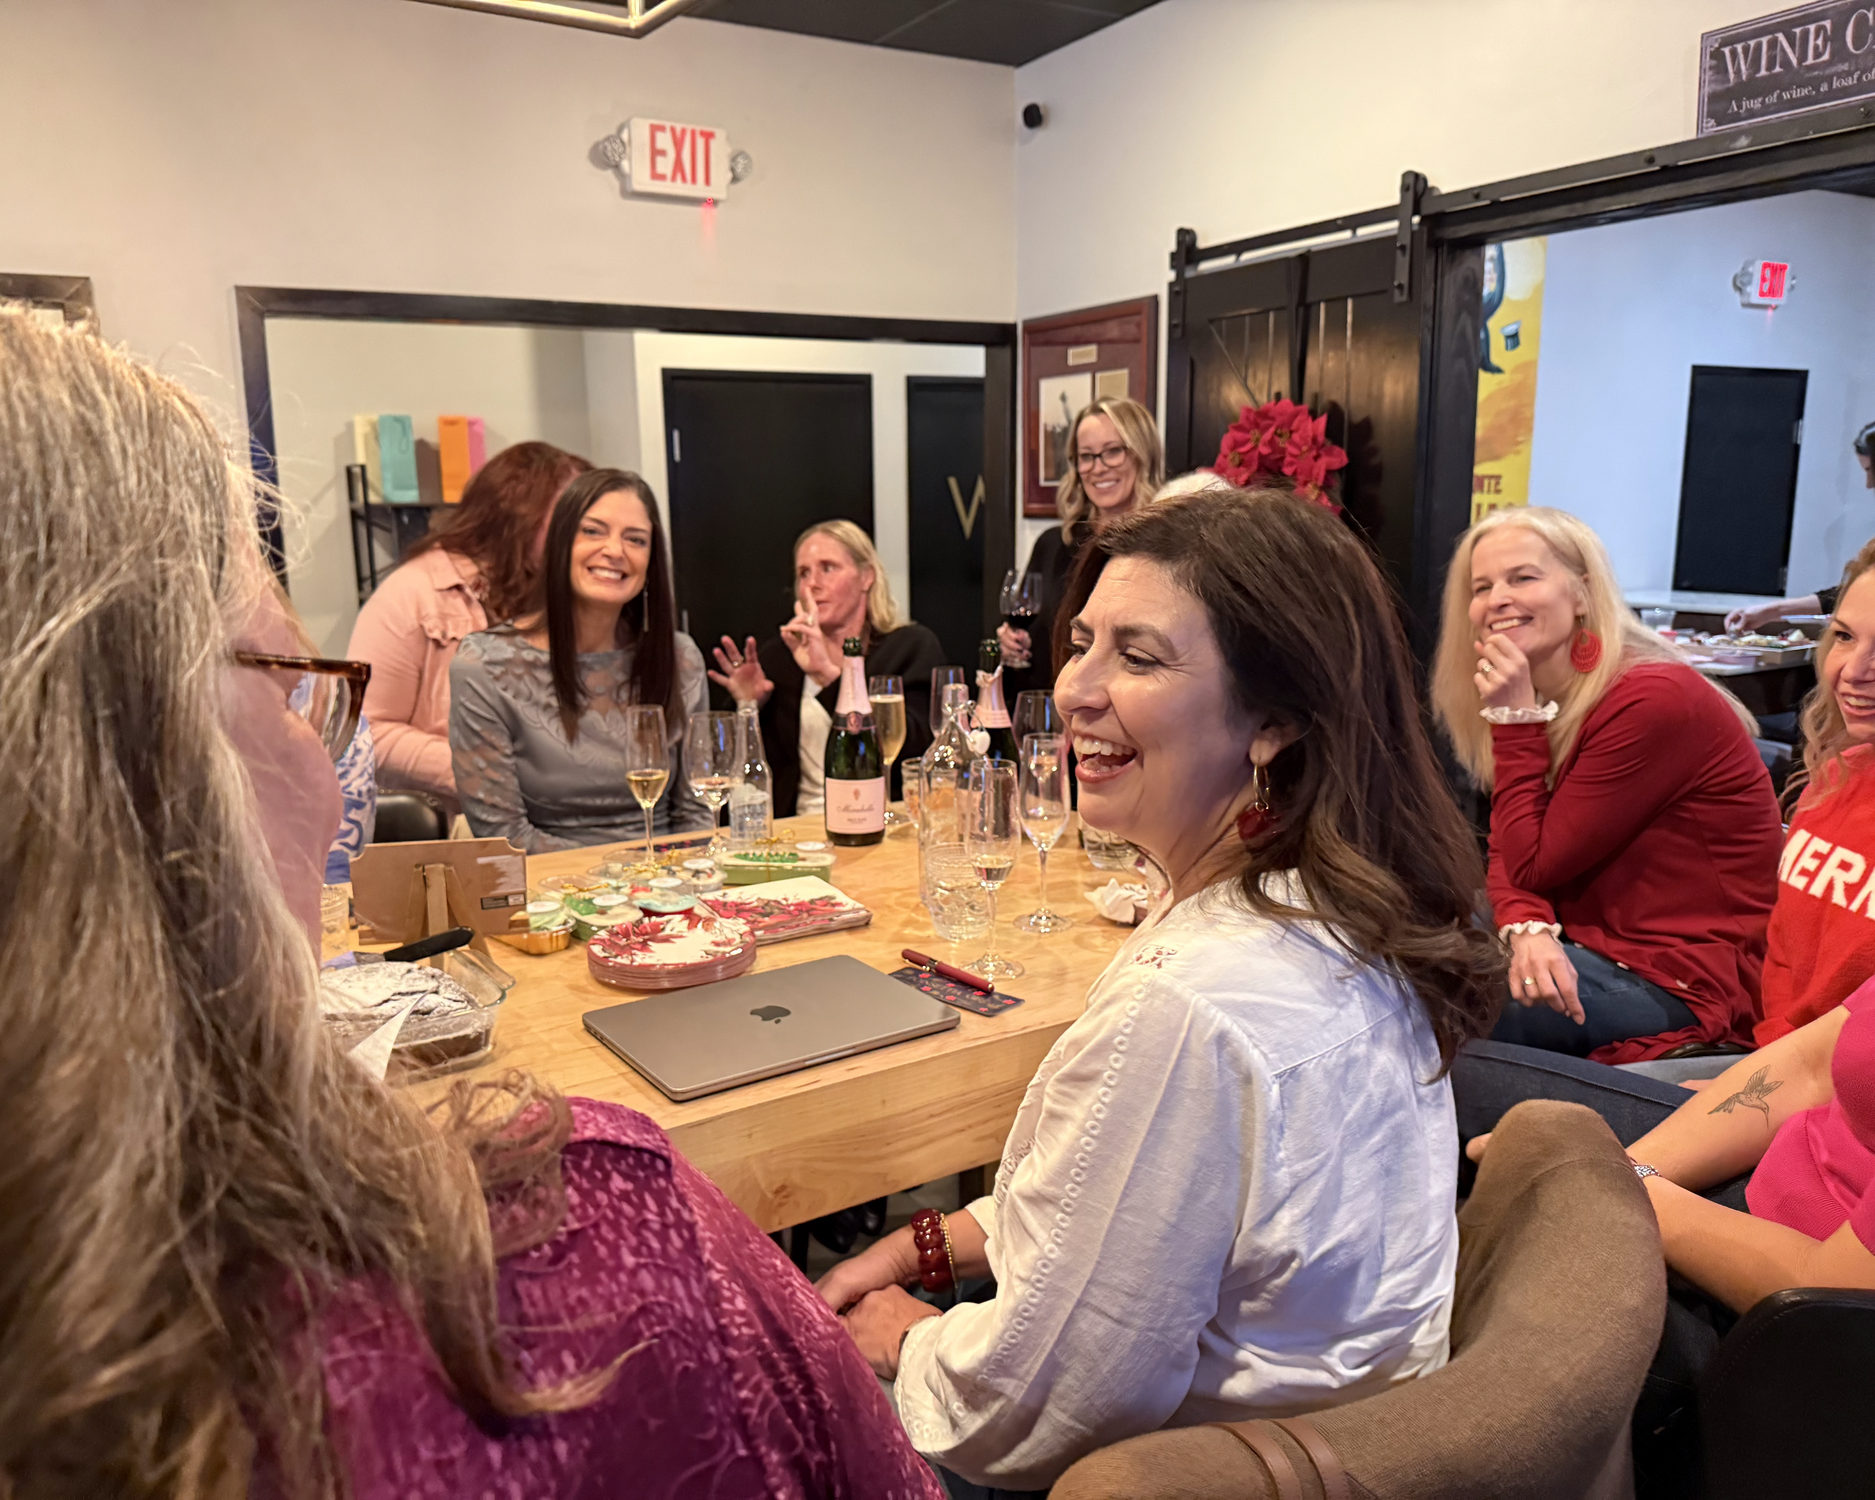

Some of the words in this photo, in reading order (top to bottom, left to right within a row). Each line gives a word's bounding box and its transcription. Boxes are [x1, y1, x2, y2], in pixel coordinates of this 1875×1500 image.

[1720, 19, 1832, 87] WINE
[1845, 7, 1875, 54] C
[1727, 100, 1738, 114] A
[1739, 97, 1763, 114] jug
[1765, 90, 1780, 105] of
[1782, 85, 1816, 100] wine,
[1820, 82, 1829, 92] a
[1832, 71, 1860, 89] loaf
[649, 123, 716, 187] EXIT
[1758, 261, 1789, 300] EXIT
